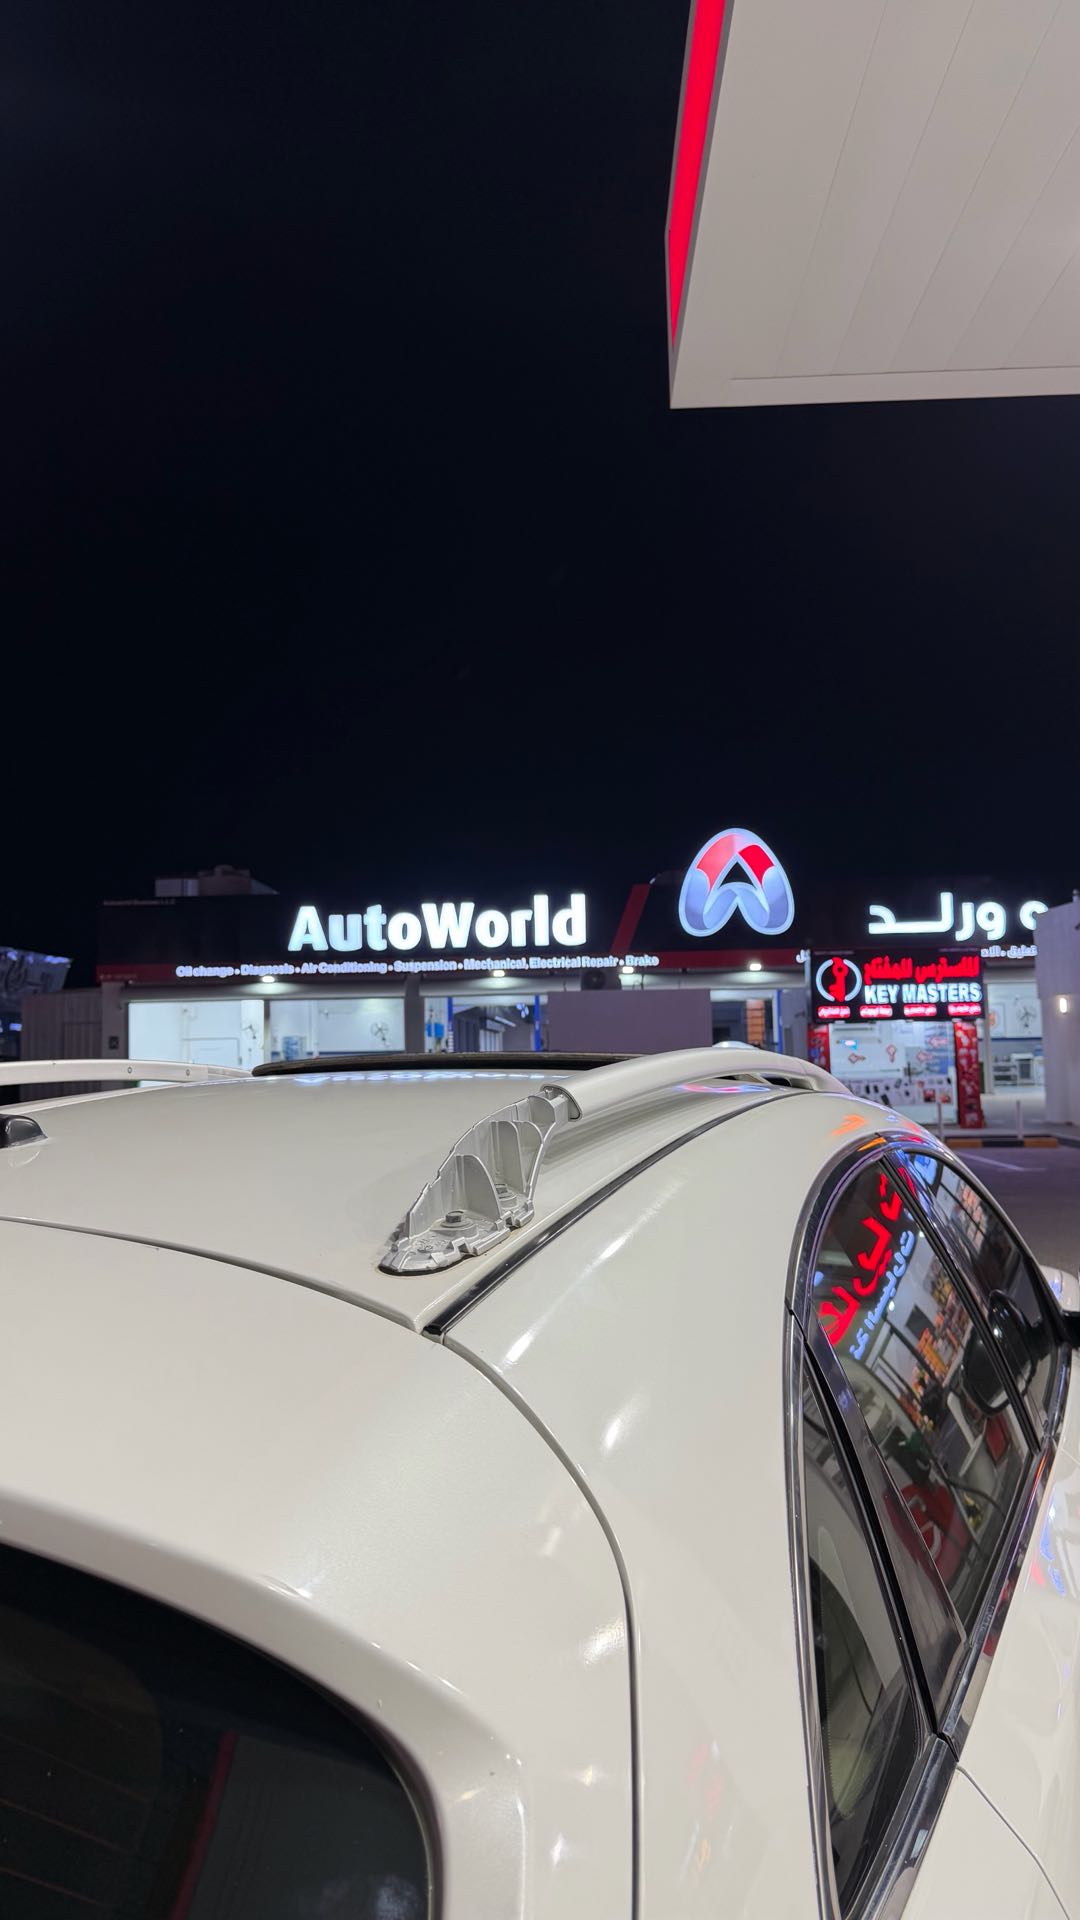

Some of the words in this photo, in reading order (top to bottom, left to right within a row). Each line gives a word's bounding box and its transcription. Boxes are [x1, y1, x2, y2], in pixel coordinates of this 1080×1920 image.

[287, 893, 587, 951] AutoWorld
[176, 965, 193, 977] Oil
[193, 965, 234, 978] change
[240, 963, 295, 976] Diagnosis
[301, 963, 318, 974] Air
[318, 961, 388, 974] Conditioning
[393, 959, 458, 973] Suspension
[463, 957, 529, 970] Mechanical,
[529, 956, 581, 969] Electrical
[581, 955, 619, 968] Repair
[625, 954, 660, 967] Brake
[864, 984, 899, 1005] KEY
[902, 982, 983, 1004] MASTERS
